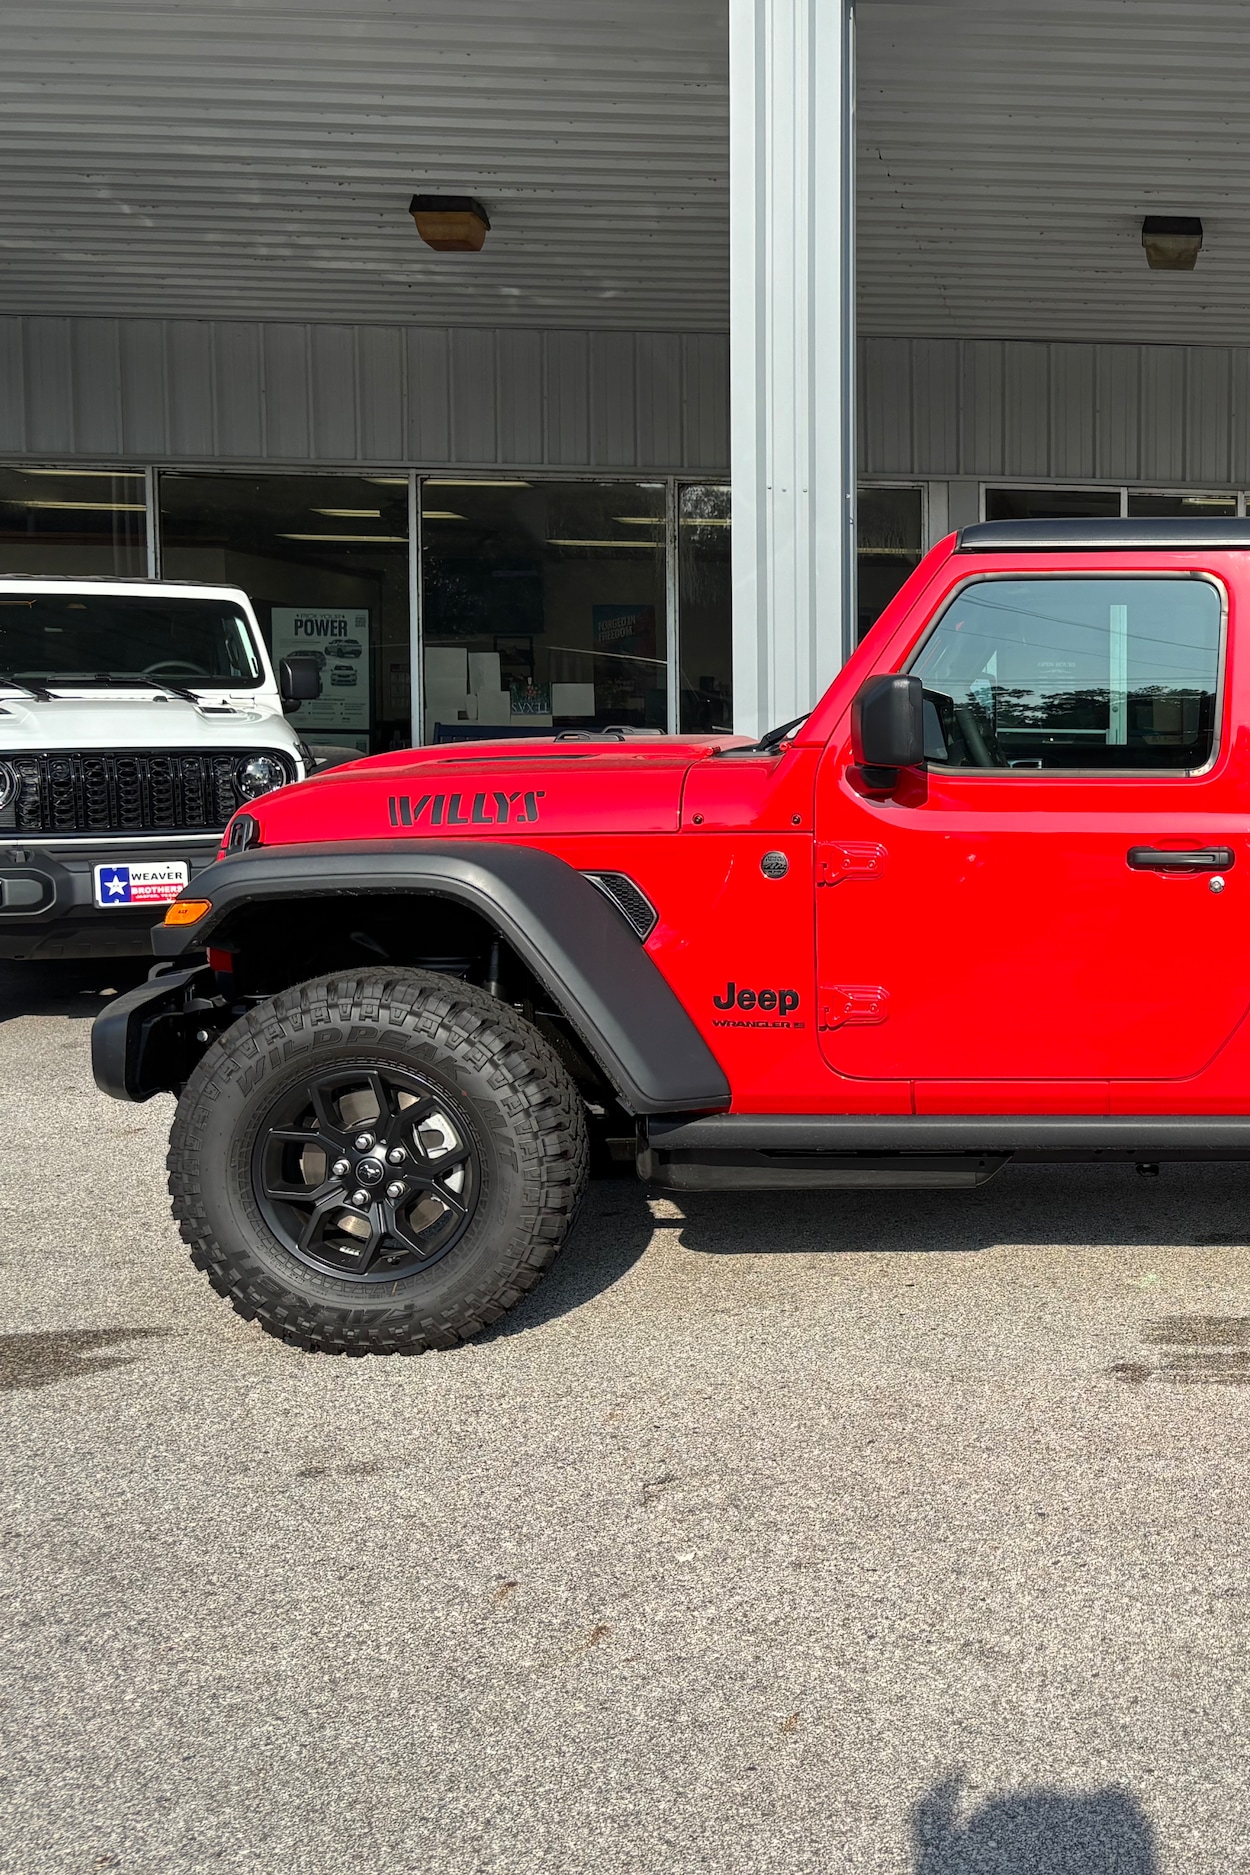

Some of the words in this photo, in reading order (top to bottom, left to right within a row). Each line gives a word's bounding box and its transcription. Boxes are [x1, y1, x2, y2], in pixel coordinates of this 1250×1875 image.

[294, 618, 348, 637] POWER
[511, 702, 550, 714] TEXAS
[388, 791, 546, 826] WILLYS
[131, 872, 183, 881] WEAVER
[131, 885, 184, 895] BROTHERS
[713, 982, 800, 1016] Jeep
[712, 1019, 791, 1029] WRANGLER
[236, 1026, 472, 1097] WILDPEAK
